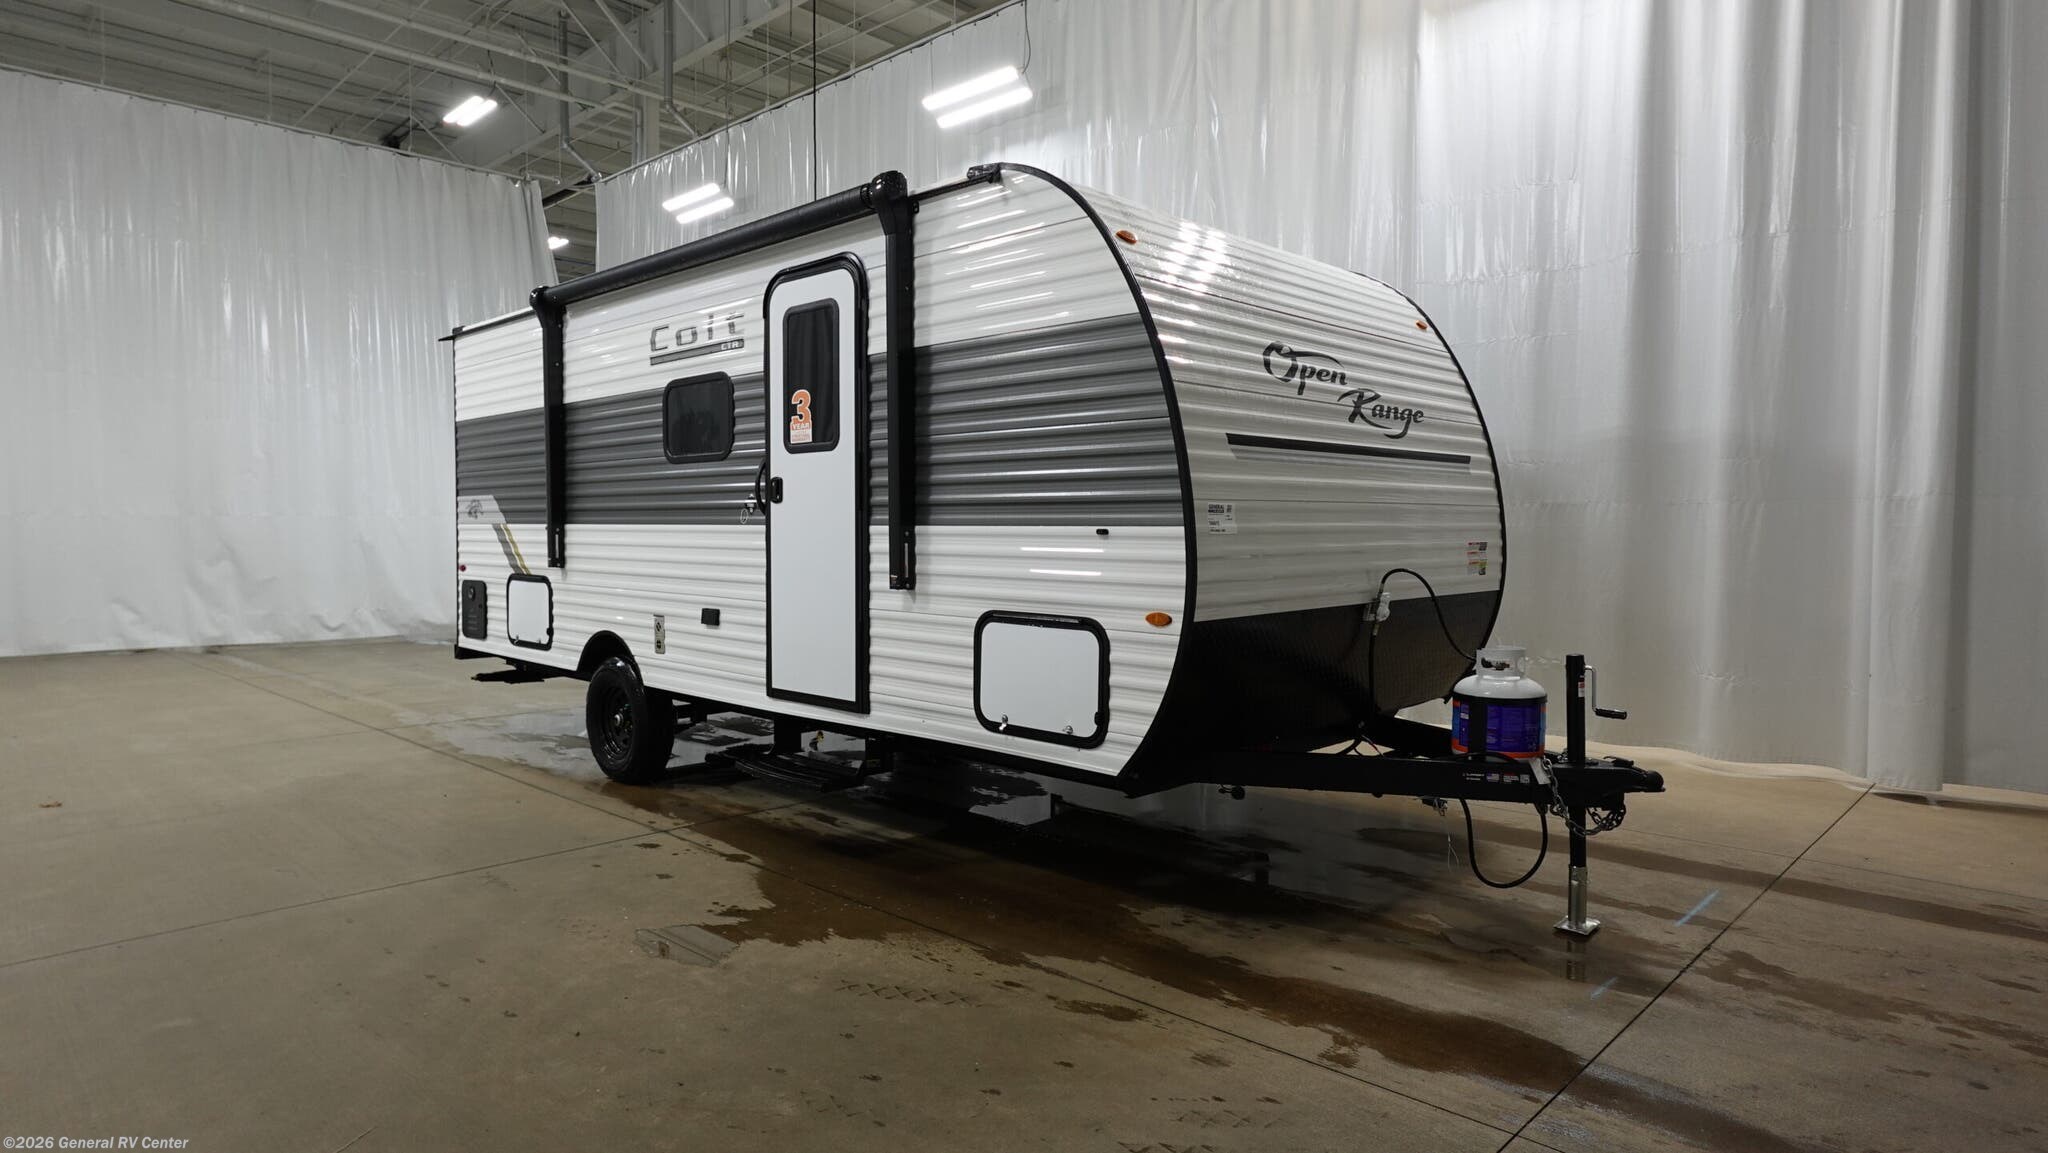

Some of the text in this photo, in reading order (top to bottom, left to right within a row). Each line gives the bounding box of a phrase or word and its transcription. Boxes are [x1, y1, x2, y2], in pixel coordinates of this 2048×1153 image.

[721, 341, 739, 351] CTR
[1262, 341, 1348, 396] Open
[791, 389, 811, 424] 3
[1337, 388, 1425, 439] Range
